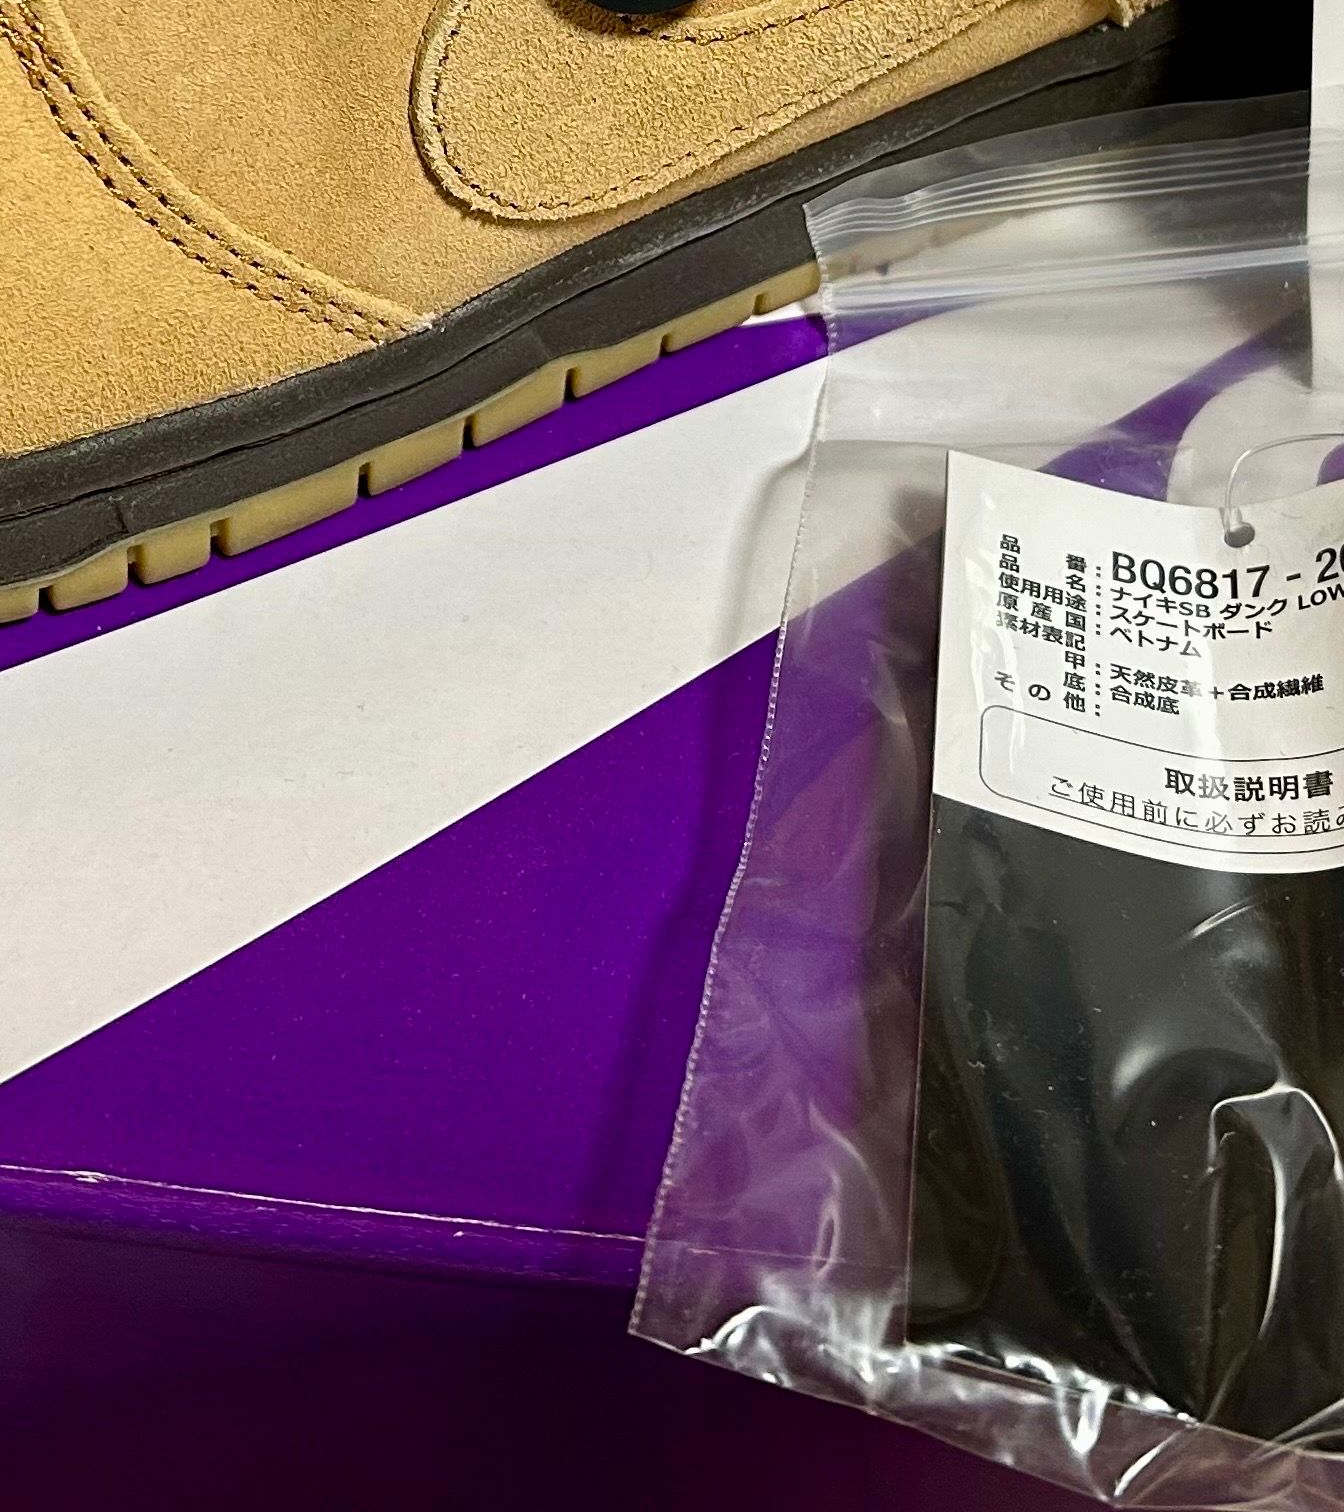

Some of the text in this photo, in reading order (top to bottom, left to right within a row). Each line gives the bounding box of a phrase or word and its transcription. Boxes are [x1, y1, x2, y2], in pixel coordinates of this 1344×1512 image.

[1111, 550, 1271, 600] BQ6817
[1109, 586, 1212, 619] ナイキSB
[1219, 597, 1289, 621] ダンク
[1109, 604, 1273, 641] スケートボード
[1109, 625, 1203, 659] ベトナム
[1109, 684, 1181, 716] 合成底
[1164, 766, 1335, 803] 取扱説明書
